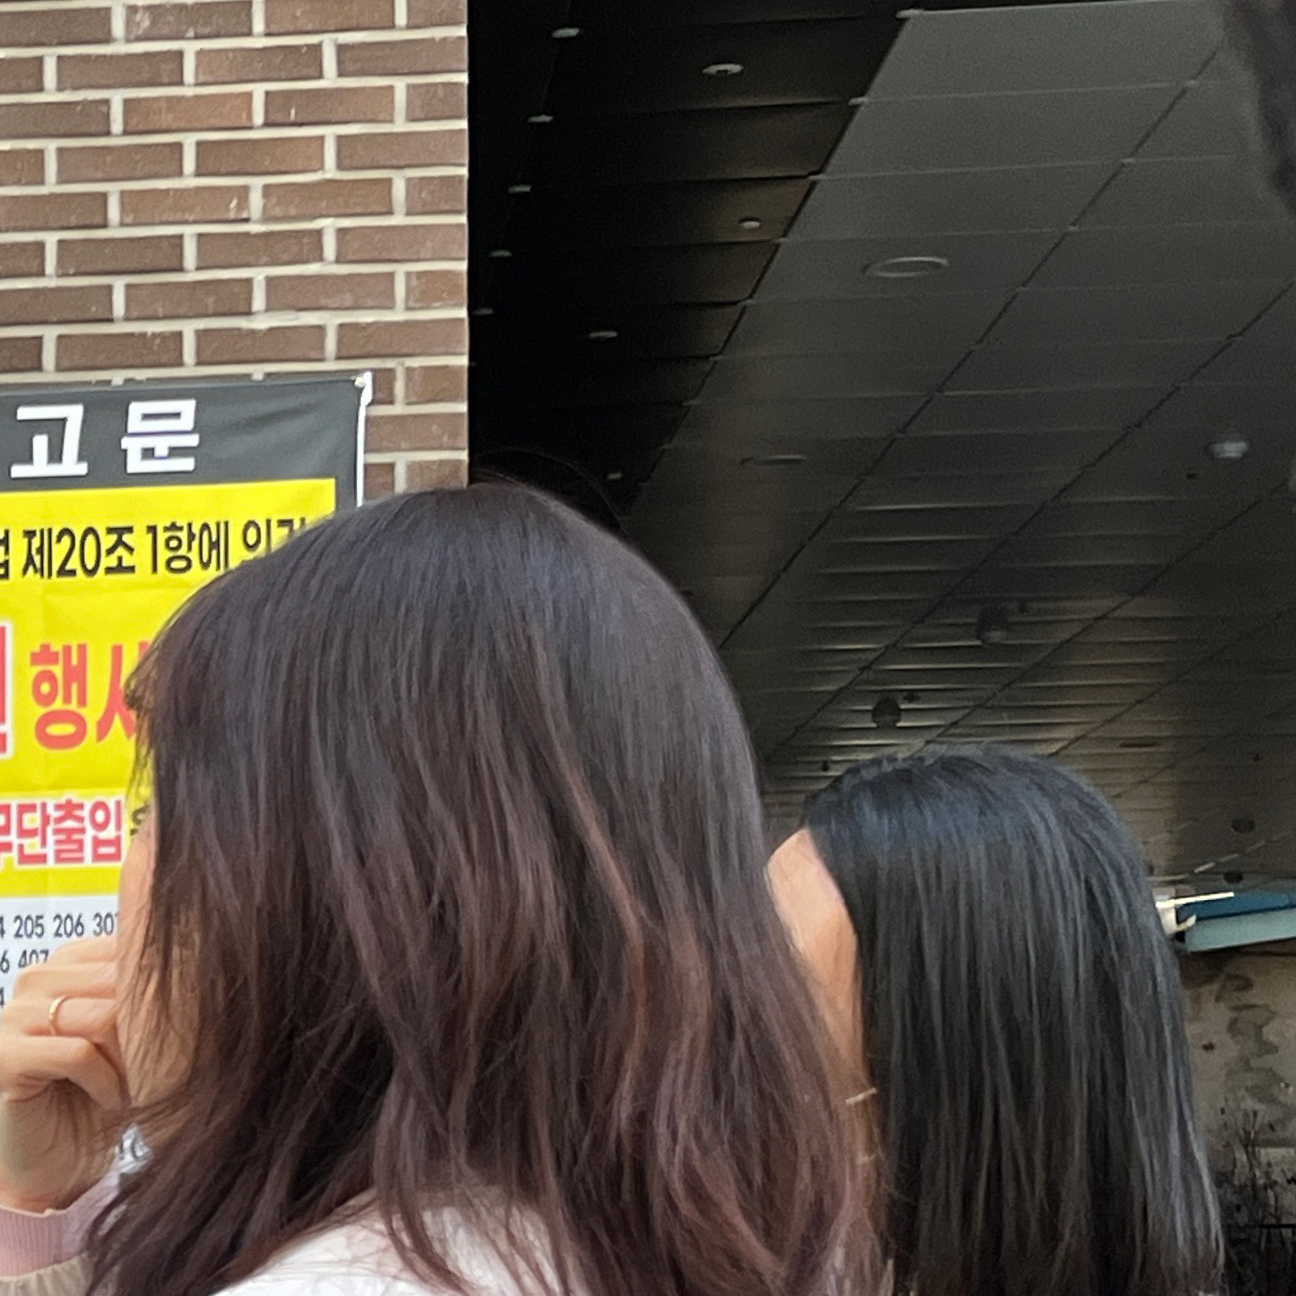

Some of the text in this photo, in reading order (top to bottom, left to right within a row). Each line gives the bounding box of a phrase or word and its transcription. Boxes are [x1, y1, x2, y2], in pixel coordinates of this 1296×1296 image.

[12, 913, 45, 939] 205
[52, 913, 85, 938] 206
[92, 912, 119, 937] 30
